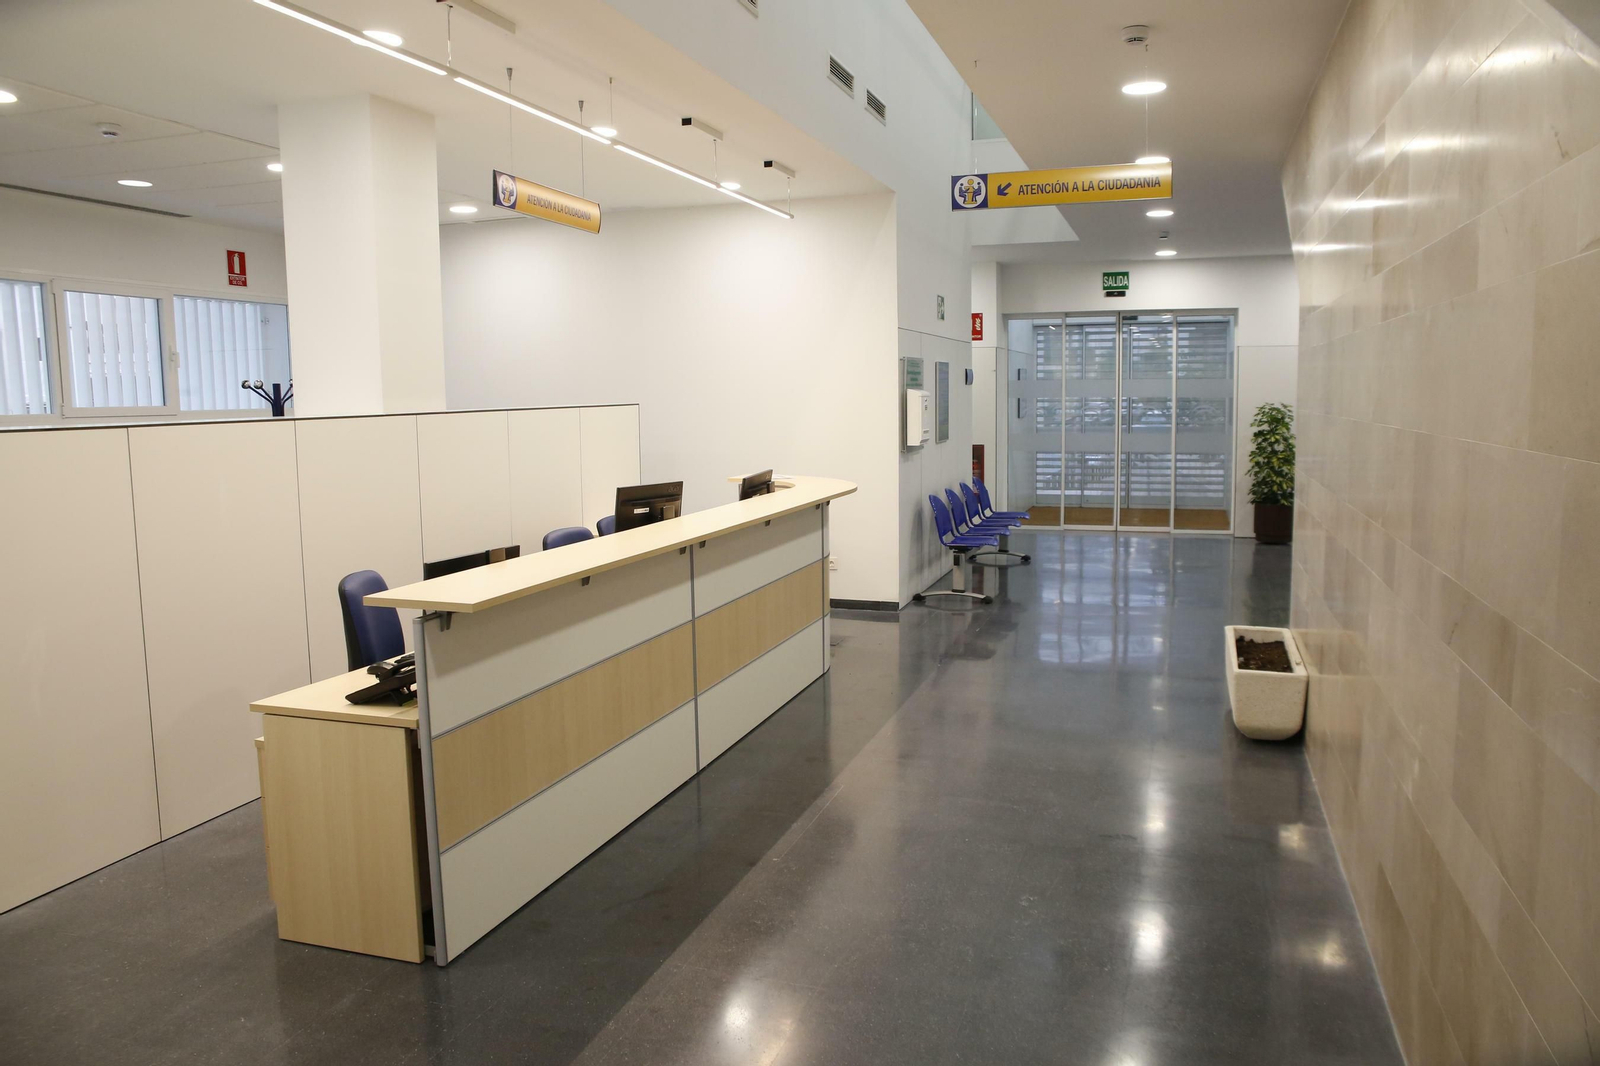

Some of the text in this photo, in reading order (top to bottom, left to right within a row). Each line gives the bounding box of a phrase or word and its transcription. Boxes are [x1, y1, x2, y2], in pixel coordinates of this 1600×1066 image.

[1018, 175, 1161, 196] ATENCIÓN A LA CIUDADANÍA
[1103, 275, 1129, 287] SALIDA
